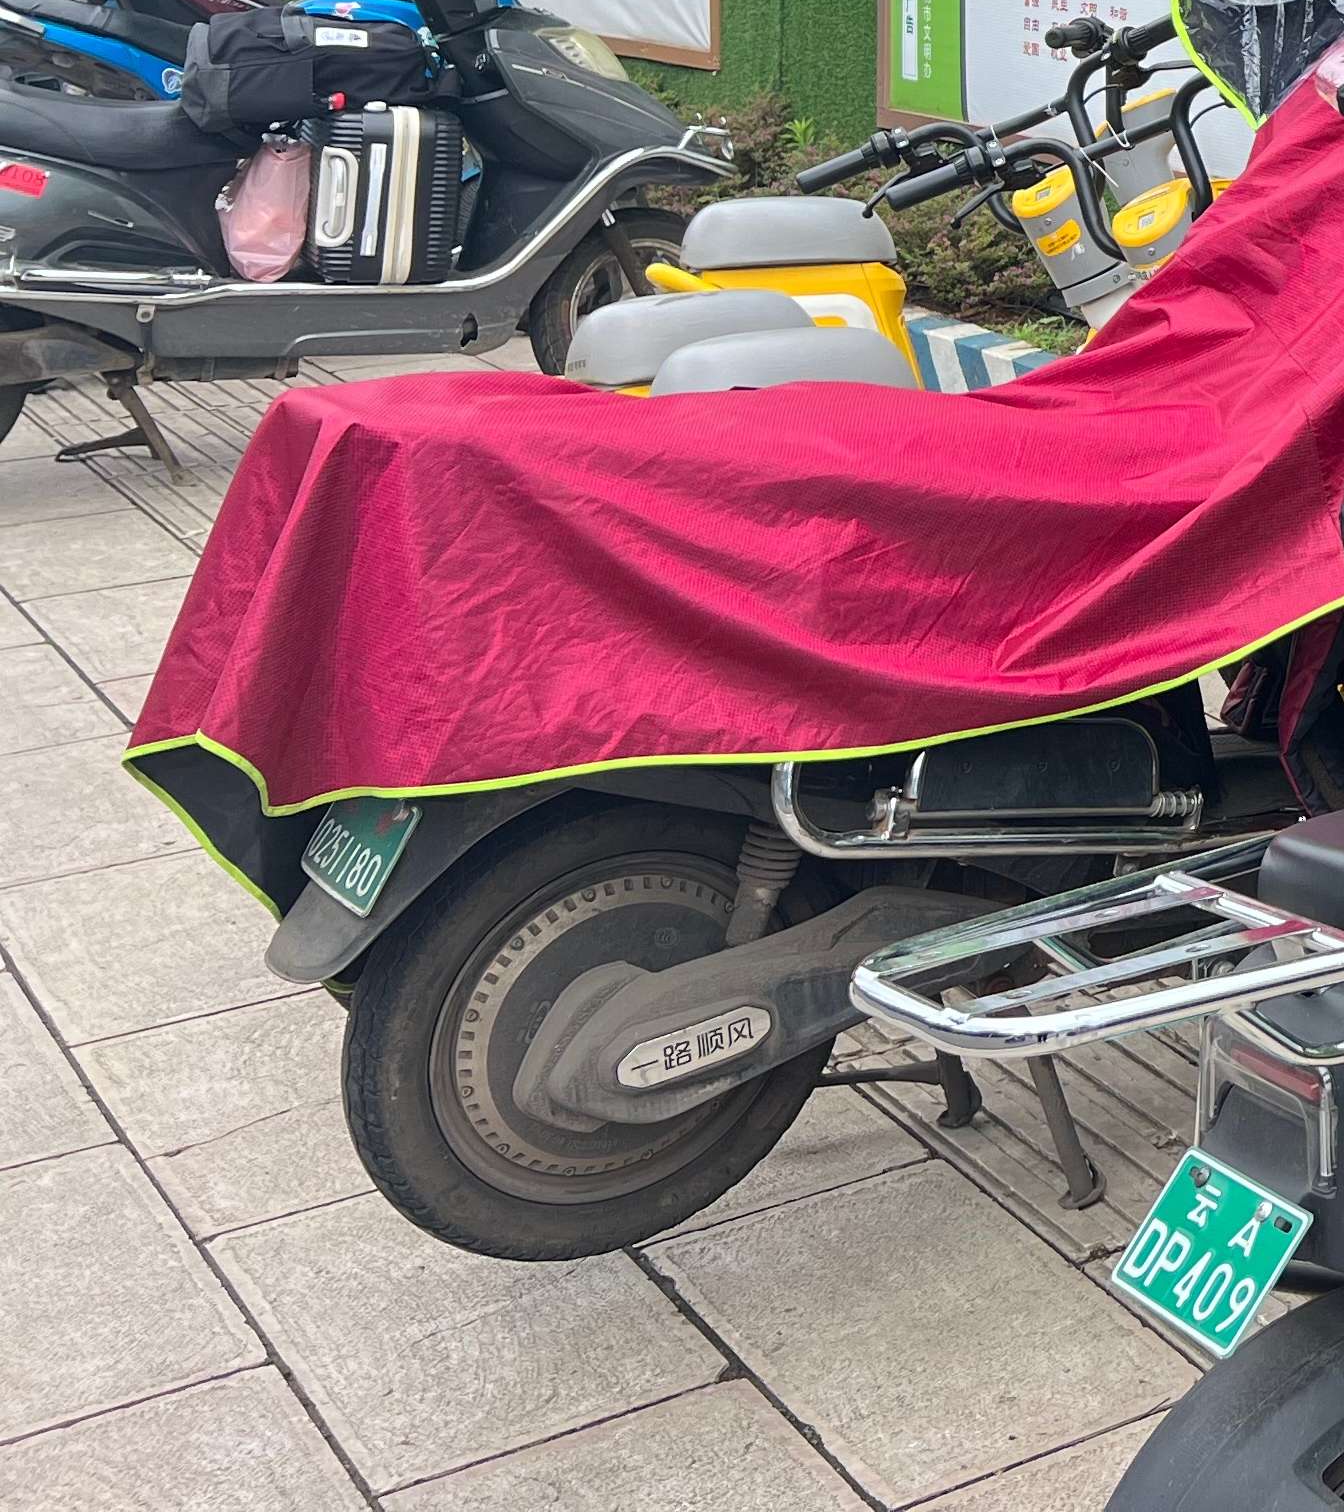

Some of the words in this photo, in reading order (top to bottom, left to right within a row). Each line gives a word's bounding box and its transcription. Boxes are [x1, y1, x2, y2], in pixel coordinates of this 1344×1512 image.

[307, 818, 382, 897] 0251180
[631, 1017, 755, 1071] 一路顺风
[1122, 1217, 1257, 1333] DP409
